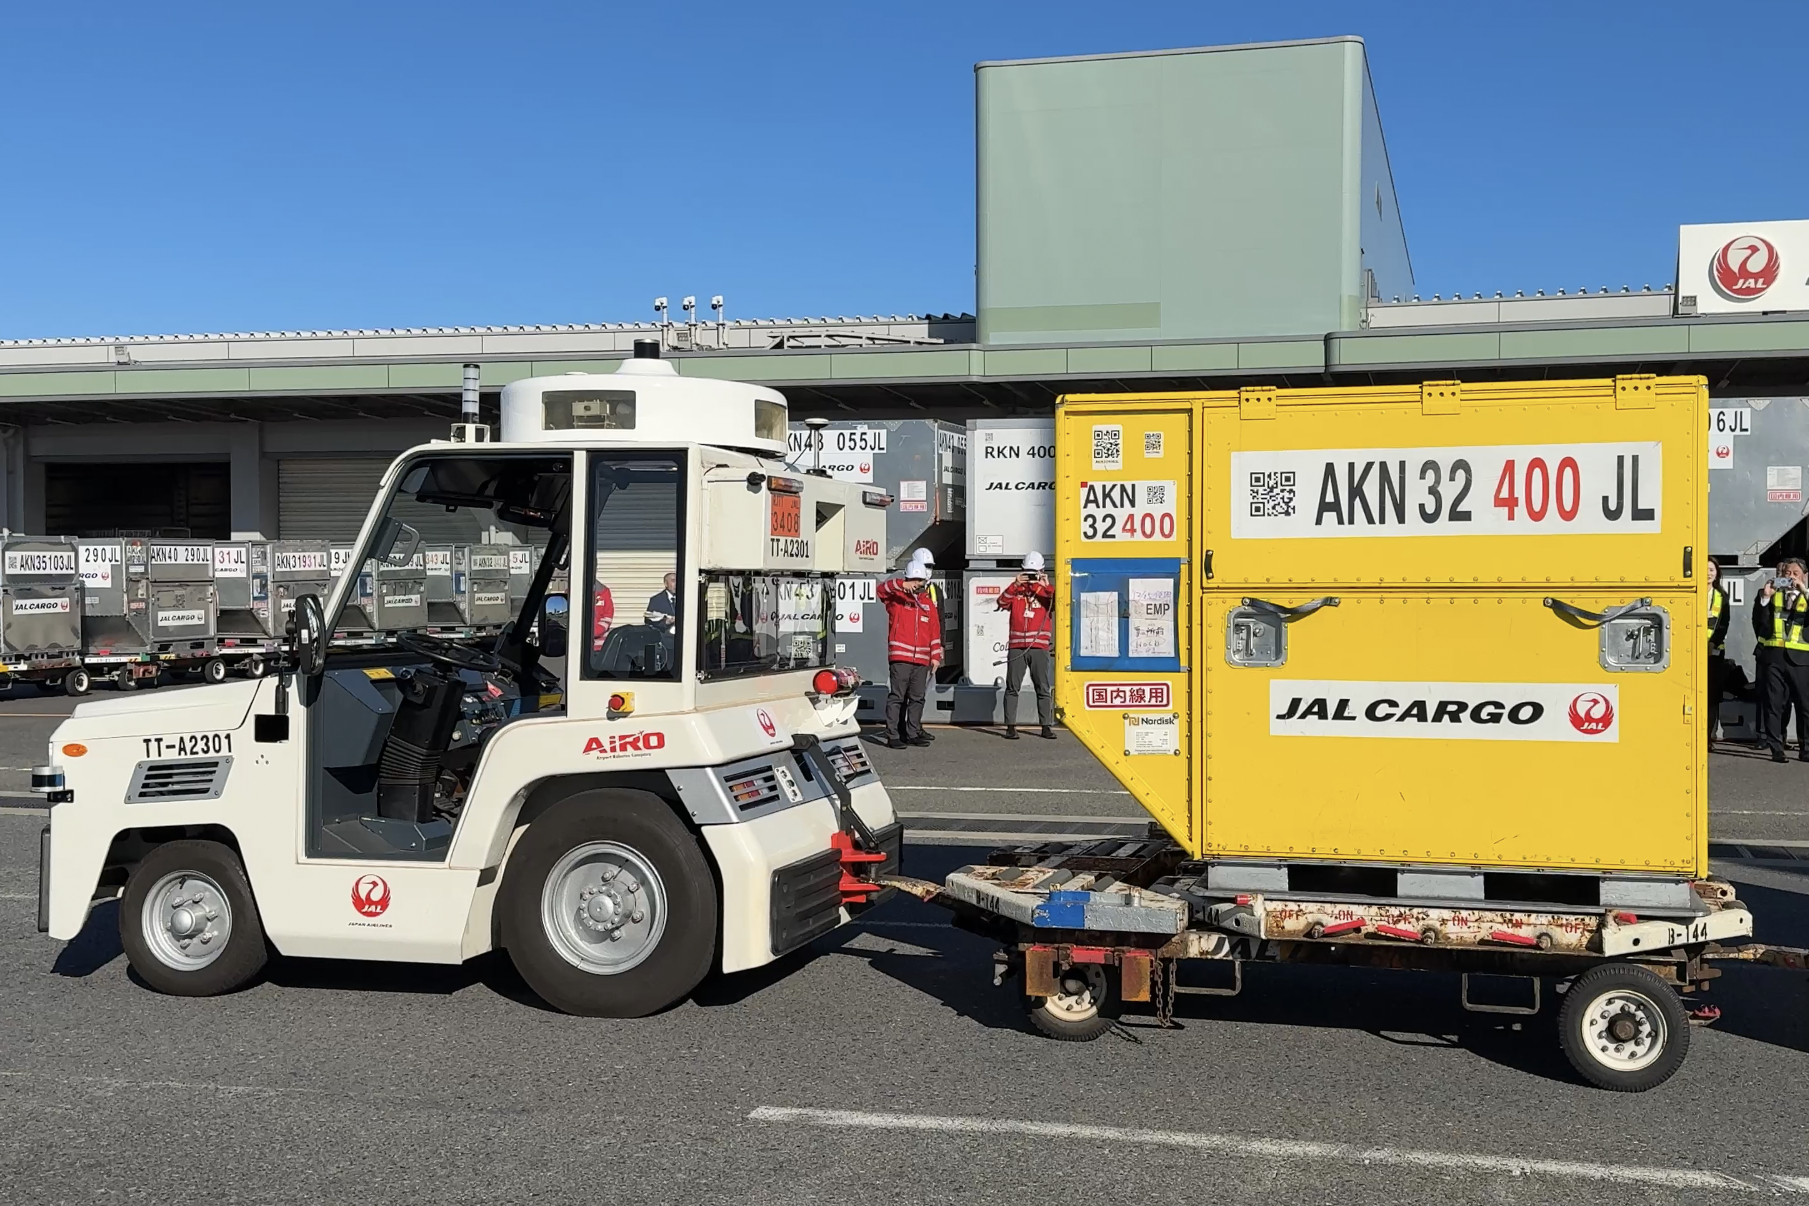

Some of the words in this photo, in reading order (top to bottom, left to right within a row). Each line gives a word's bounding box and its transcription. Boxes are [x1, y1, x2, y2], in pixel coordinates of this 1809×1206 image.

[1733, 278, 1767, 290] JAL
[1709, 411, 1748, 432] 6JL
[837, 431, 885, 451] 055JL
[985, 446, 1020, 459] RKN
[985, 482, 1012, 491] JAL
[1083, 483, 1136, 509] AKN
[1493, 457, 1580, 522] 400
[1601, 454, 1655, 521] JL
[772, 511, 799, 533] 3408
[1083, 512, 1175, 540] 32400
[770, 538, 810, 558] TT-A2301
[1145, 603, 1170, 616] EMP
[1092, 687, 1164, 704] 国内線用
[1275, 697, 1358, 721] JAL
[1364, 698, 1545, 725] CARGO
[1141, 717, 1175, 726] Nordisk
[1579, 722, 1606, 731] JAL
[143, 733, 232, 758] TT-A2301
[361, 904, 383, 913] JAL
[1667, 922, 1707, 946] B-144
